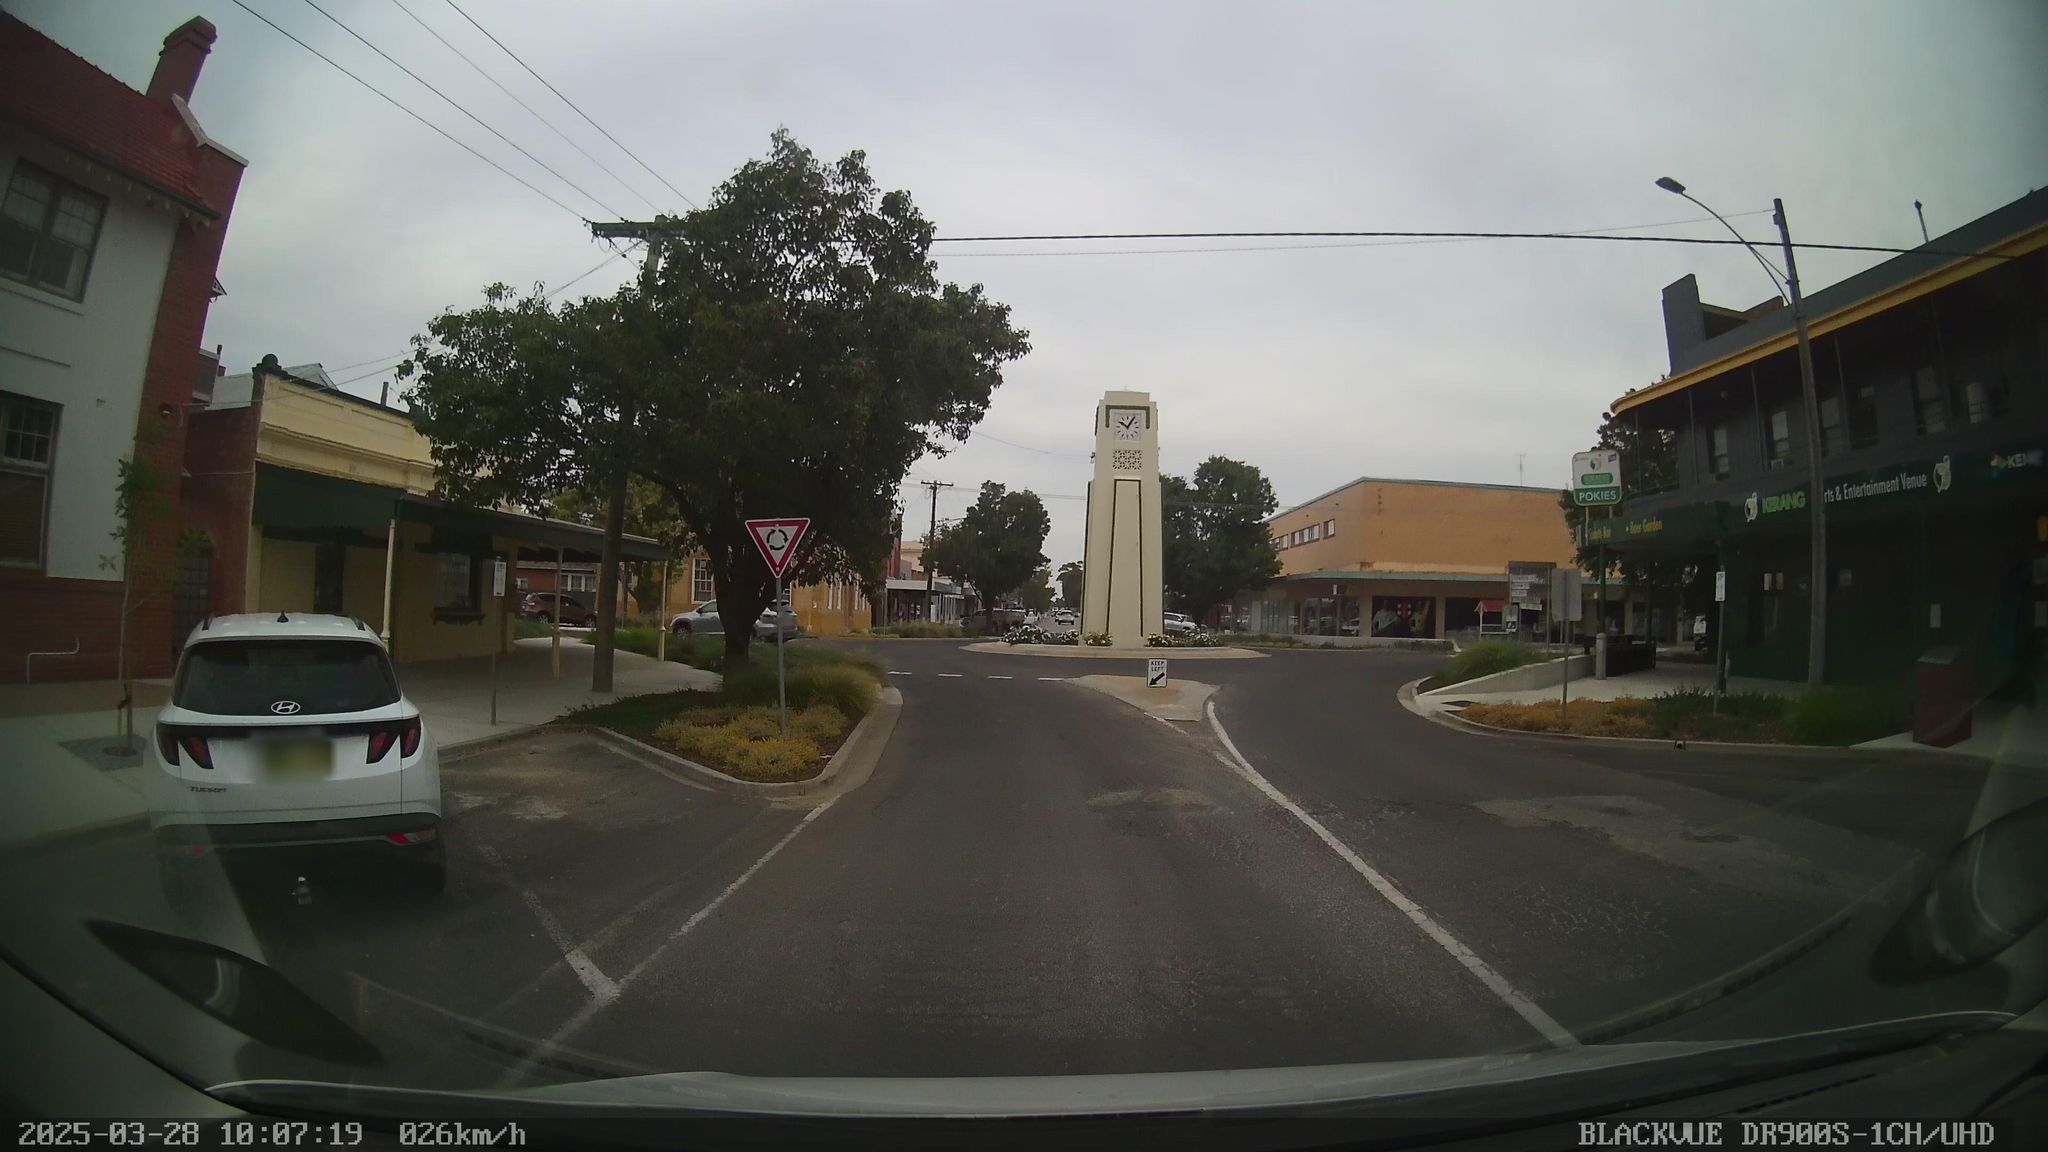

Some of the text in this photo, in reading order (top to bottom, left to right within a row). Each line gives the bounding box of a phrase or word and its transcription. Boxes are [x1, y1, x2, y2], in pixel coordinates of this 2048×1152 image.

[1579, 490, 1617, 502] POKIES
[1835, 486, 1843, 501] &
[1843, 476, 1900, 500] Entertainment
[1900, 472, 1928, 490] Venue
